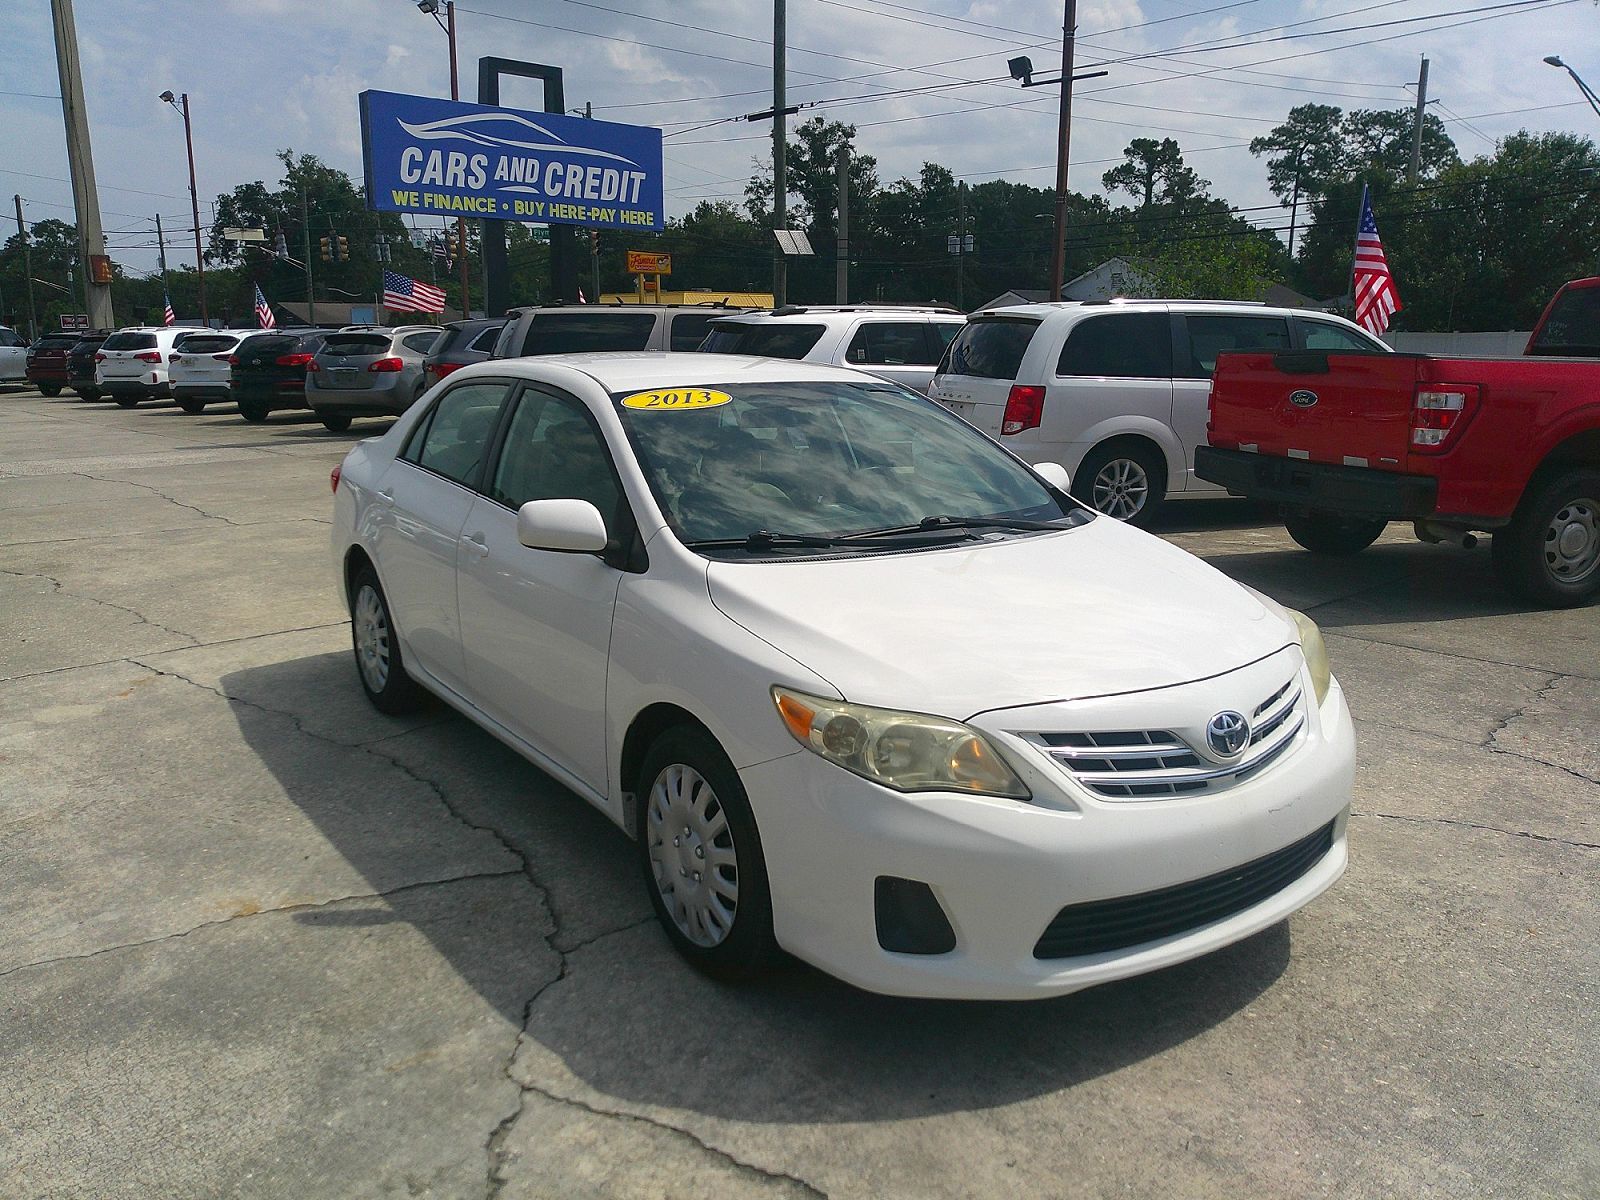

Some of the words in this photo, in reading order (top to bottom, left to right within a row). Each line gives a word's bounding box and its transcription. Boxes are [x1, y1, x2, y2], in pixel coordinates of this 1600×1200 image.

[400, 146, 489, 190] CARS
[494, 155, 540, 184] AND
[544, 161, 646, 203] CREDIT
[392, 190, 420, 207] WE
[424, 192, 497, 213] FINANCE
[514, 200, 545, 216] BUY
[620, 210, 654, 226] HERE
[645, 392, 711, 406] 2013
